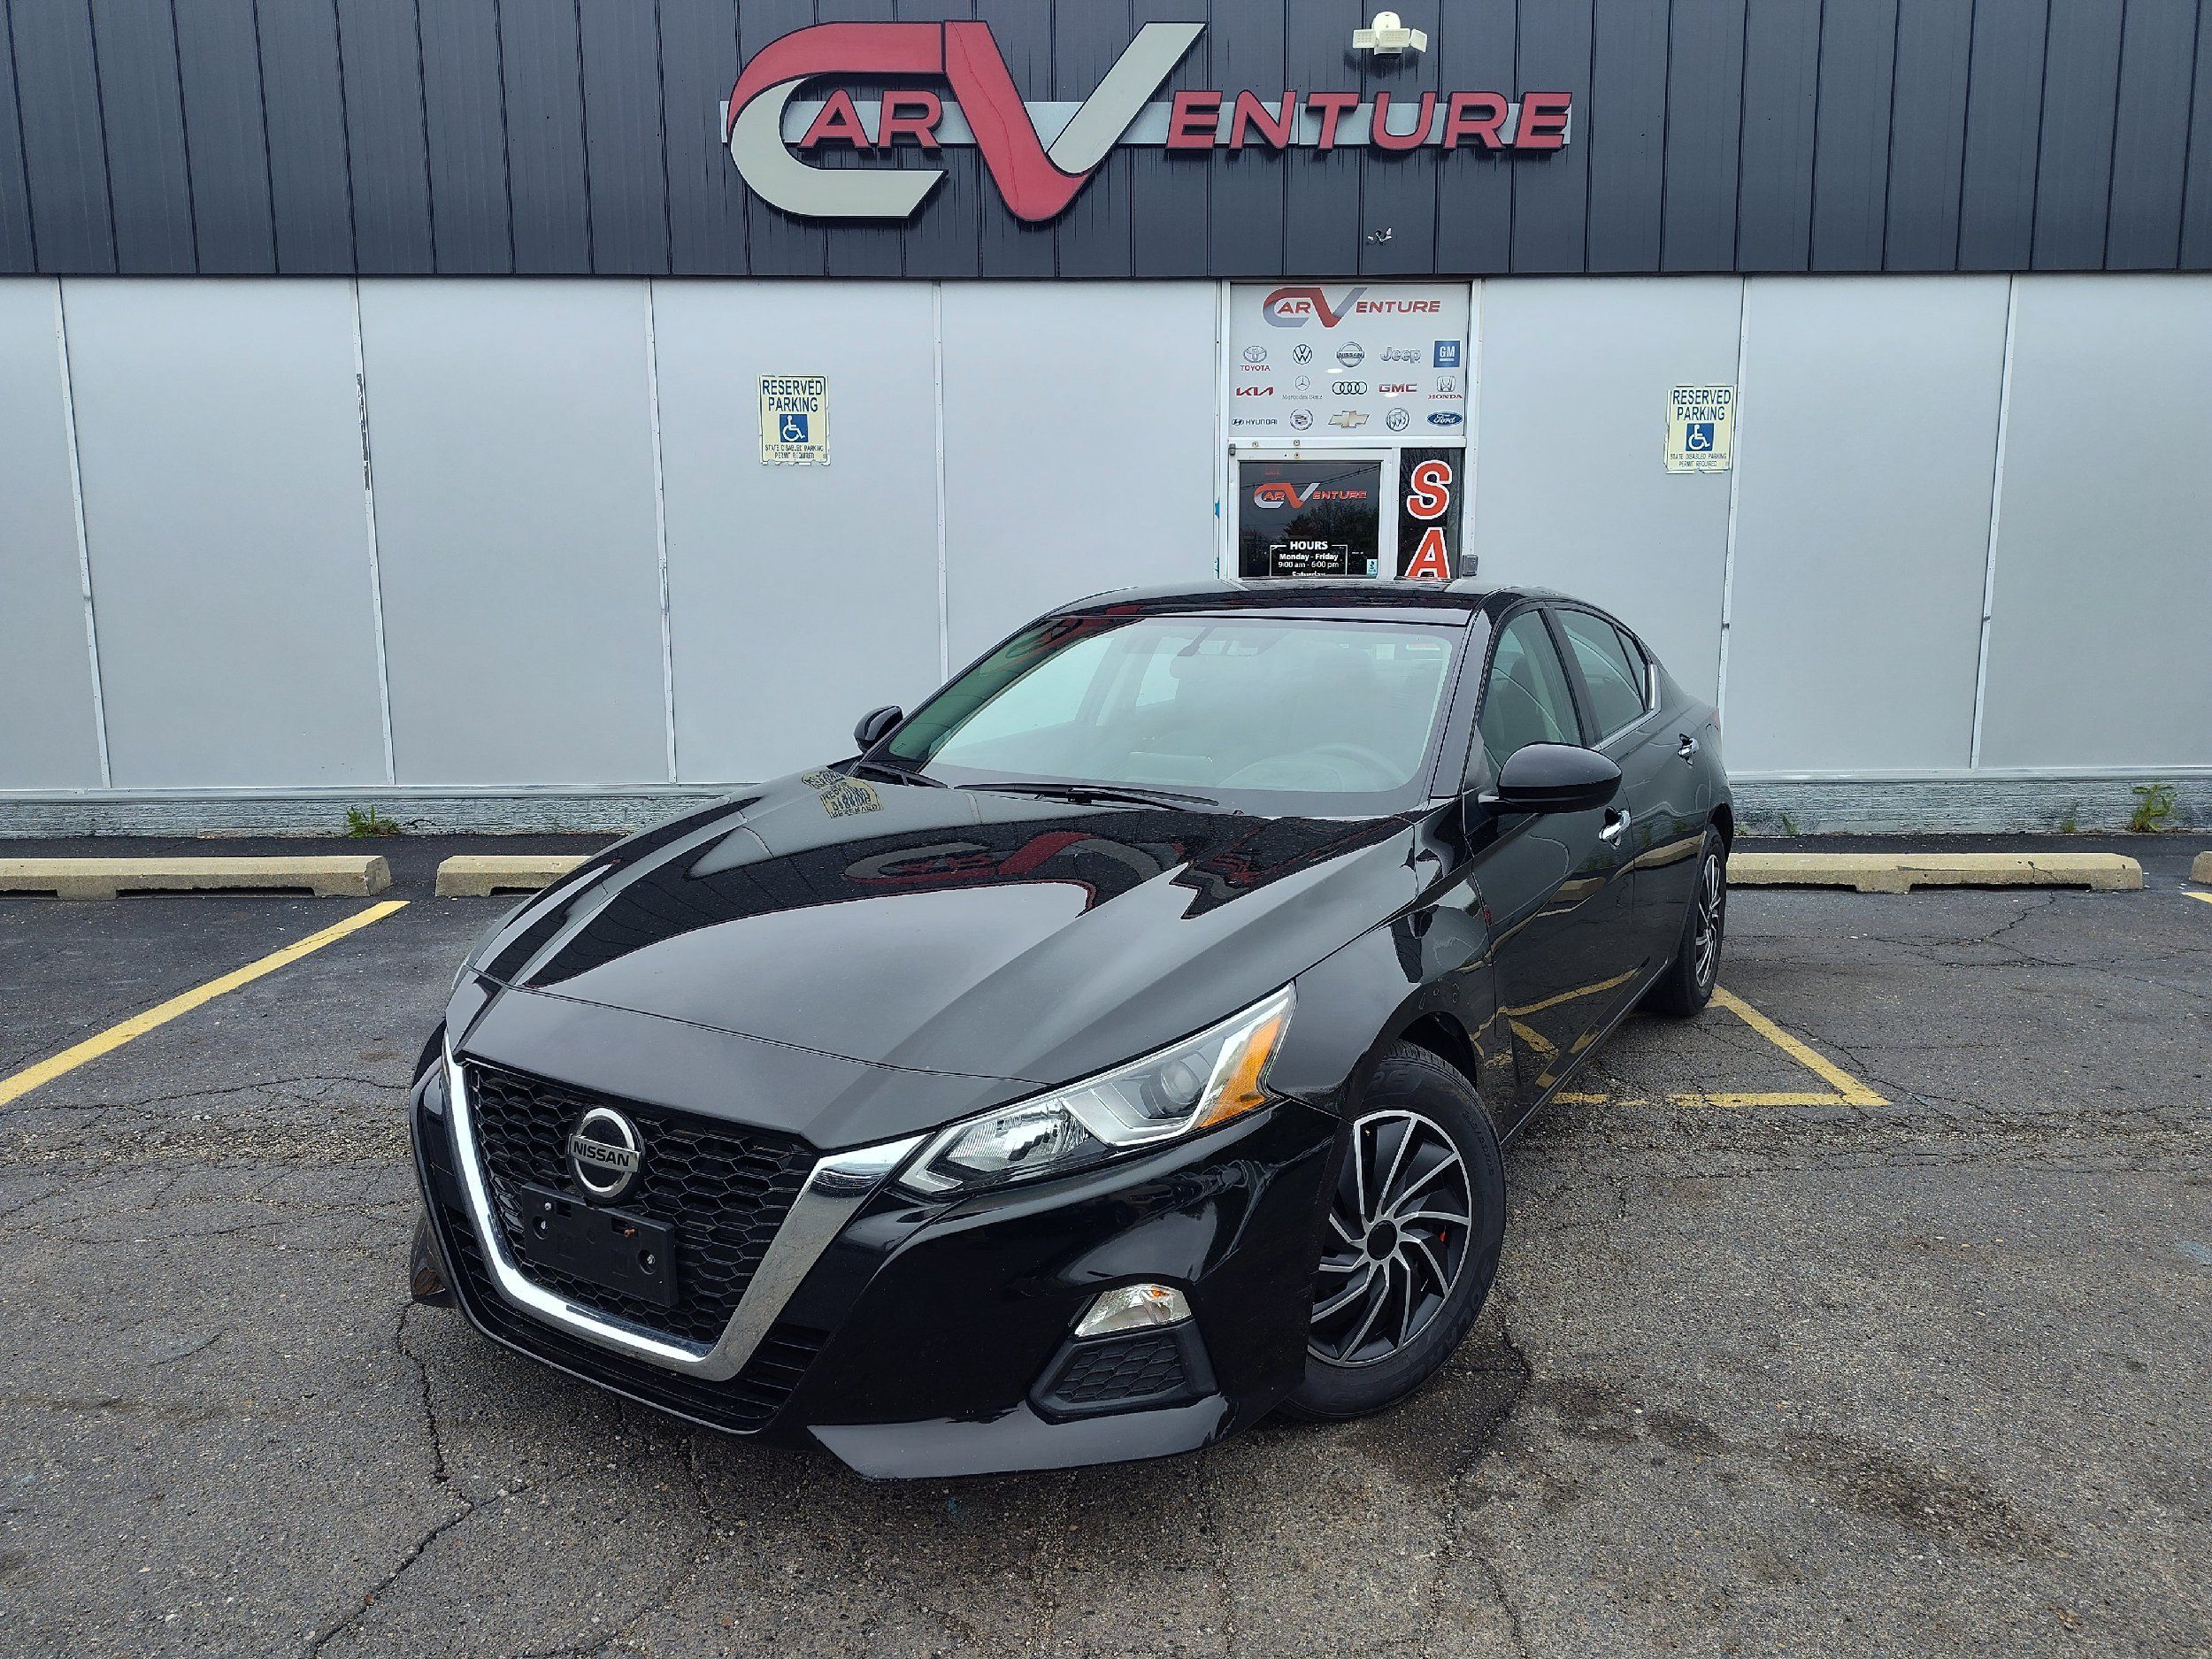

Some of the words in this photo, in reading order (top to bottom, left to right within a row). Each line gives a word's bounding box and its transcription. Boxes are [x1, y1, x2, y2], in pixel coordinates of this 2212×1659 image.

[1380, 346, 1421, 364] Jeep
[1439, 345, 1455, 357] GM
[762, 380, 823, 396] RESERVED
[1379, 383, 1417, 393] GMC
[768, 396, 818, 412] PARKING
[1672, 389, 1732, 405] RESERVED
[1432, 413, 1457, 424] Ford
[1677, 405, 1725, 421] PARKING
[1290, 541, 1328, 549] HOURS
[1279, 553, 1310, 562] Monday
[1315, 552, 1339, 562] Friday
[573, 1141, 630, 1167] NISSAN
